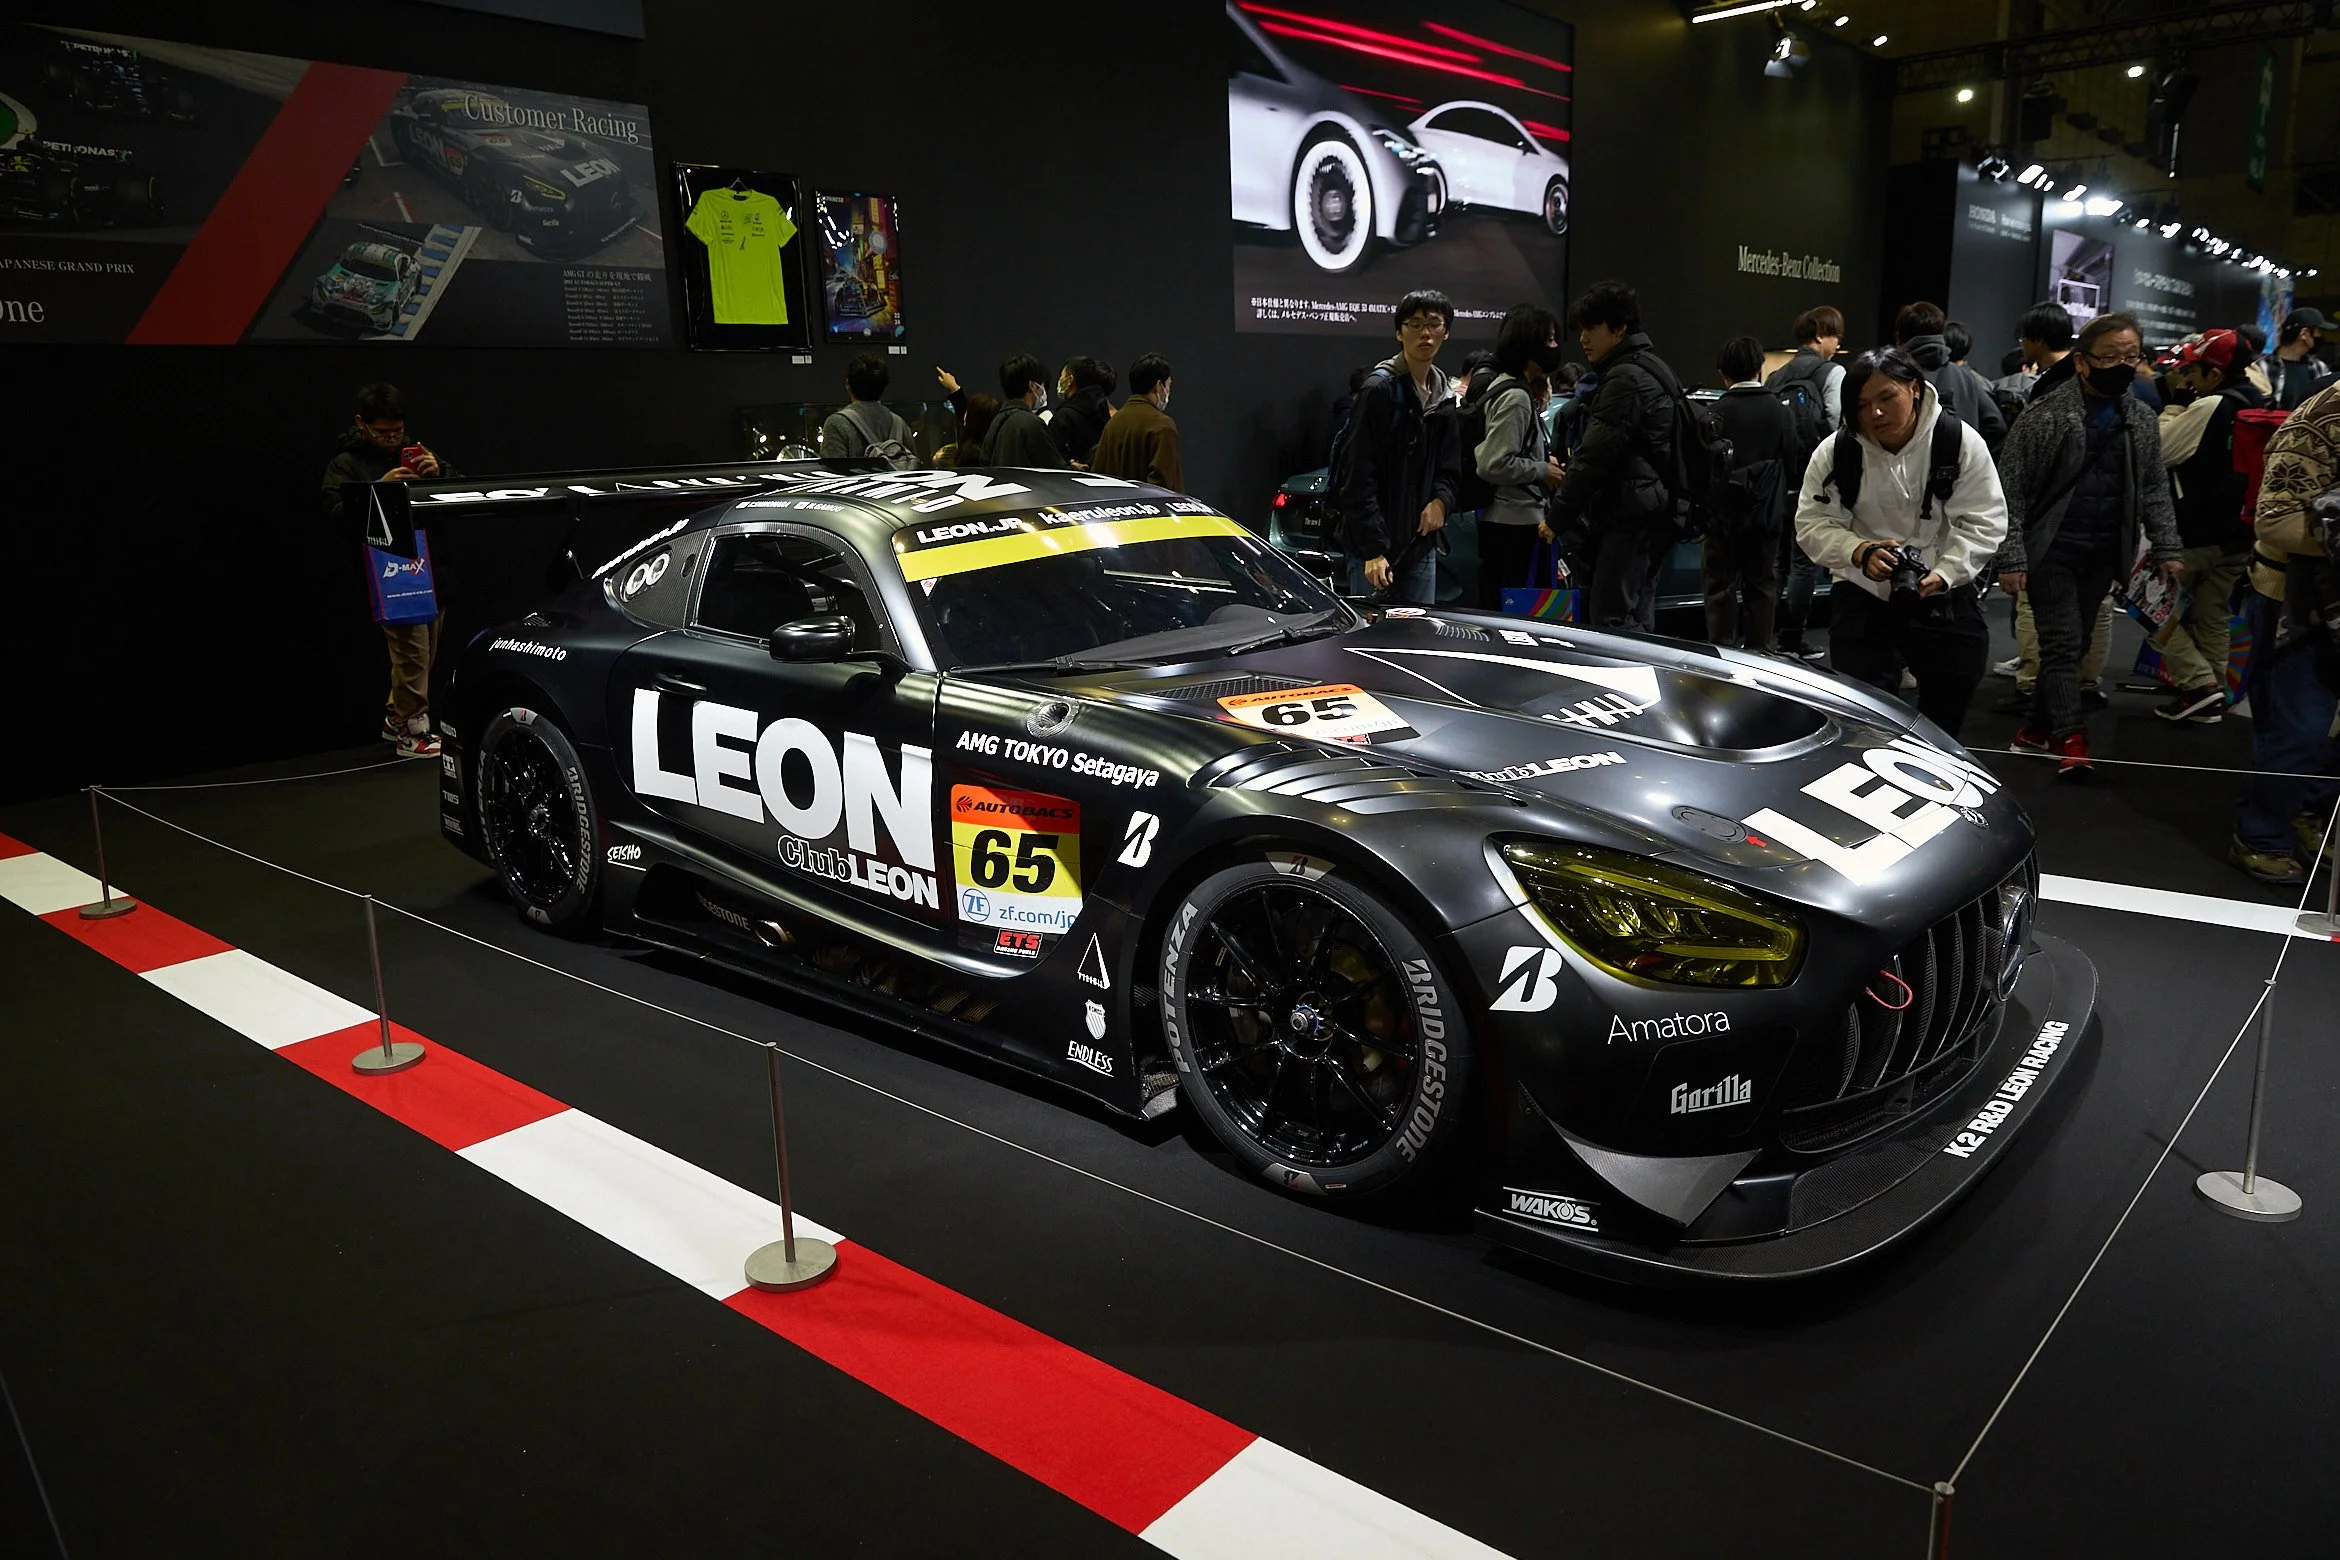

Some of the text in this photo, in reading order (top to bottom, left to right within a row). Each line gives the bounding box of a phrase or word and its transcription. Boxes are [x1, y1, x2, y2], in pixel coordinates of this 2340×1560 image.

[465, 95, 639, 144] Customer Racing
[59, 261, 102, 273] GRAND
[106, 263, 135, 274] PRIX
[1737, 244, 1841, 283] Mercedes-Benz Collection
[0, 299, 45, 323] ne
[1261, 695, 1358, 726] 65
[955, 730, 1160, 790] AMG TOKYO Setagaya
[631, 687, 937, 873] LEON
[973, 800, 1074, 820] AUTOBACS
[1740, 734, 2003, 887] LEON
[606, 845, 642, 862] SEISHO
[970, 829, 1060, 894] 65
[964, 889, 987, 915] ZF
[998, 931, 1041, 950] ETS
[1163, 901, 1199, 1074] POTENZA
[1606, 1010, 1732, 1045] Amatora
[1067, 1040, 1114, 1073] ENDLESS
[1395, 958, 1449, 1164] BRIDGESTONE
[1670, 1072, 1753, 1115] Gorilla
[1942, 1019, 2071, 1159] K2 R&D LEON RACING
